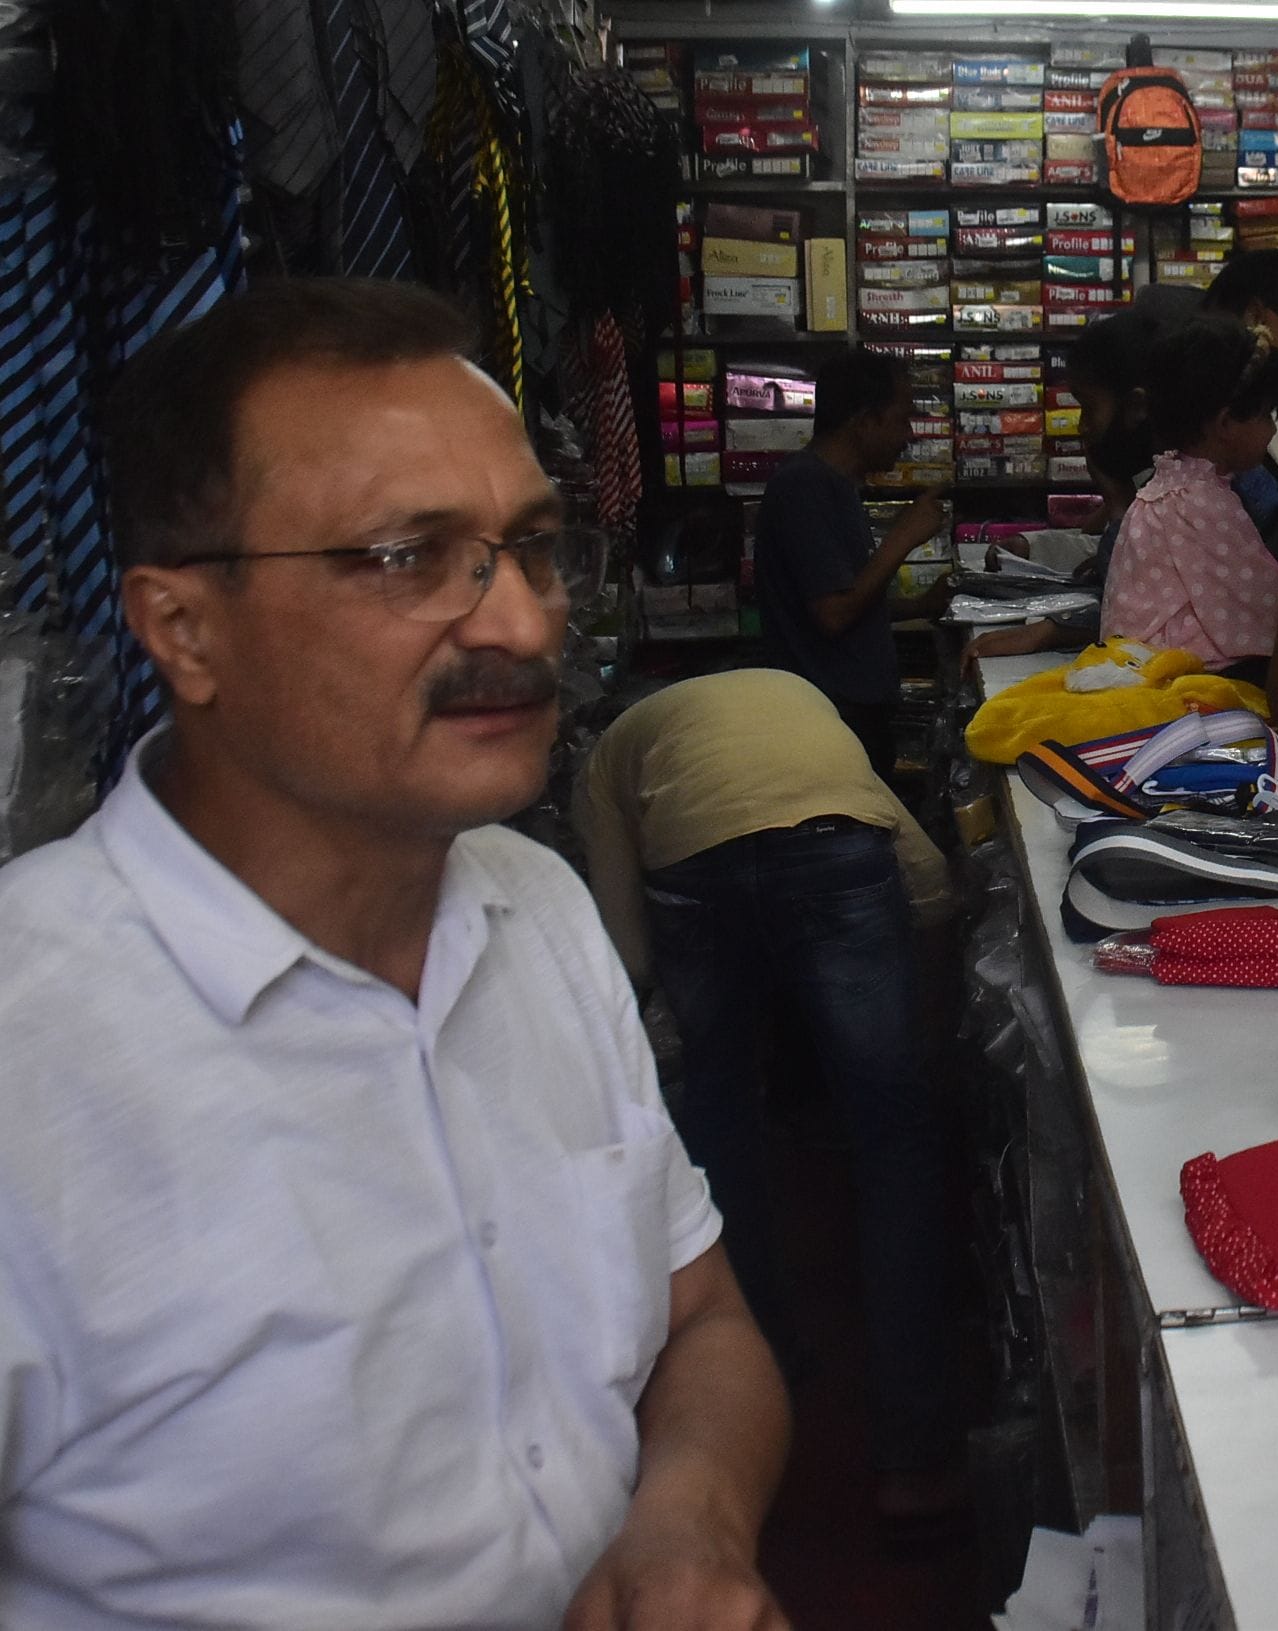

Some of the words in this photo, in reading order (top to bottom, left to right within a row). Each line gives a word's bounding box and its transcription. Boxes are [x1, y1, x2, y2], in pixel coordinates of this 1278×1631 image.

[700, 78, 748, 92] Pile
[703, 158, 748, 173] Prfile
[957, 210, 995, 226] Pfile
[865, 241, 904, 257] Prfile
[1052, 237, 1089, 251] Profile
[958, 311, 1001, 325] J.SNS
[961, 366, 997, 378] ANIL
[732, 386, 772, 400] APURVA
